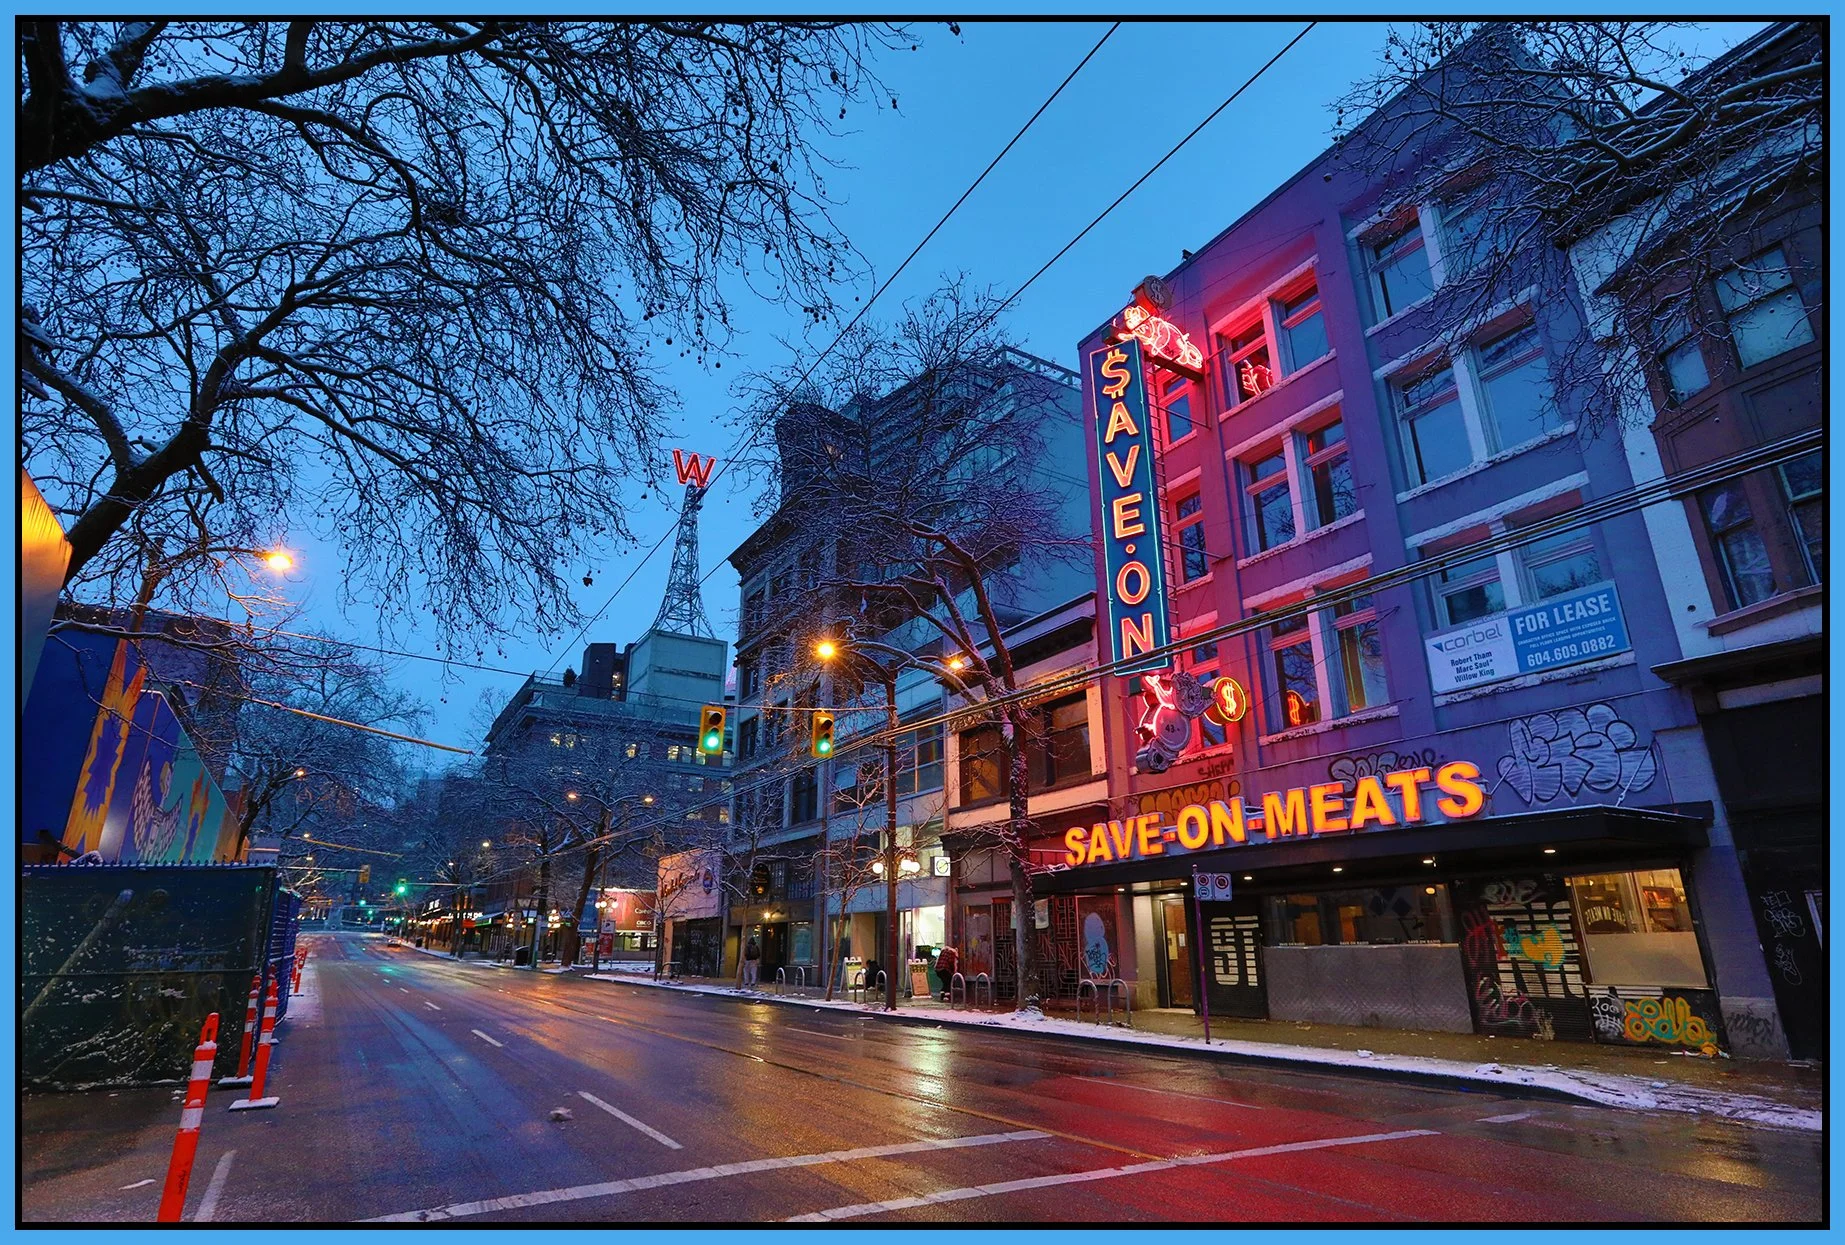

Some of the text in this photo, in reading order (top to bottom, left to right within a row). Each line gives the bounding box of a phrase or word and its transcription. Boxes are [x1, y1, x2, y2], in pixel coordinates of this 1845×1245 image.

[673, 448, 716, 488] W
[1515, 594, 1611, 635] FOR LEASE
[1444, 623, 1503, 651] corbel
[1527, 634, 1616, 667] 604.609.0882
[1450, 651, 1493, 667] Robert Tham
[1455, 662, 1474, 674] Marc
[1454, 667, 1495, 683] Willow King
